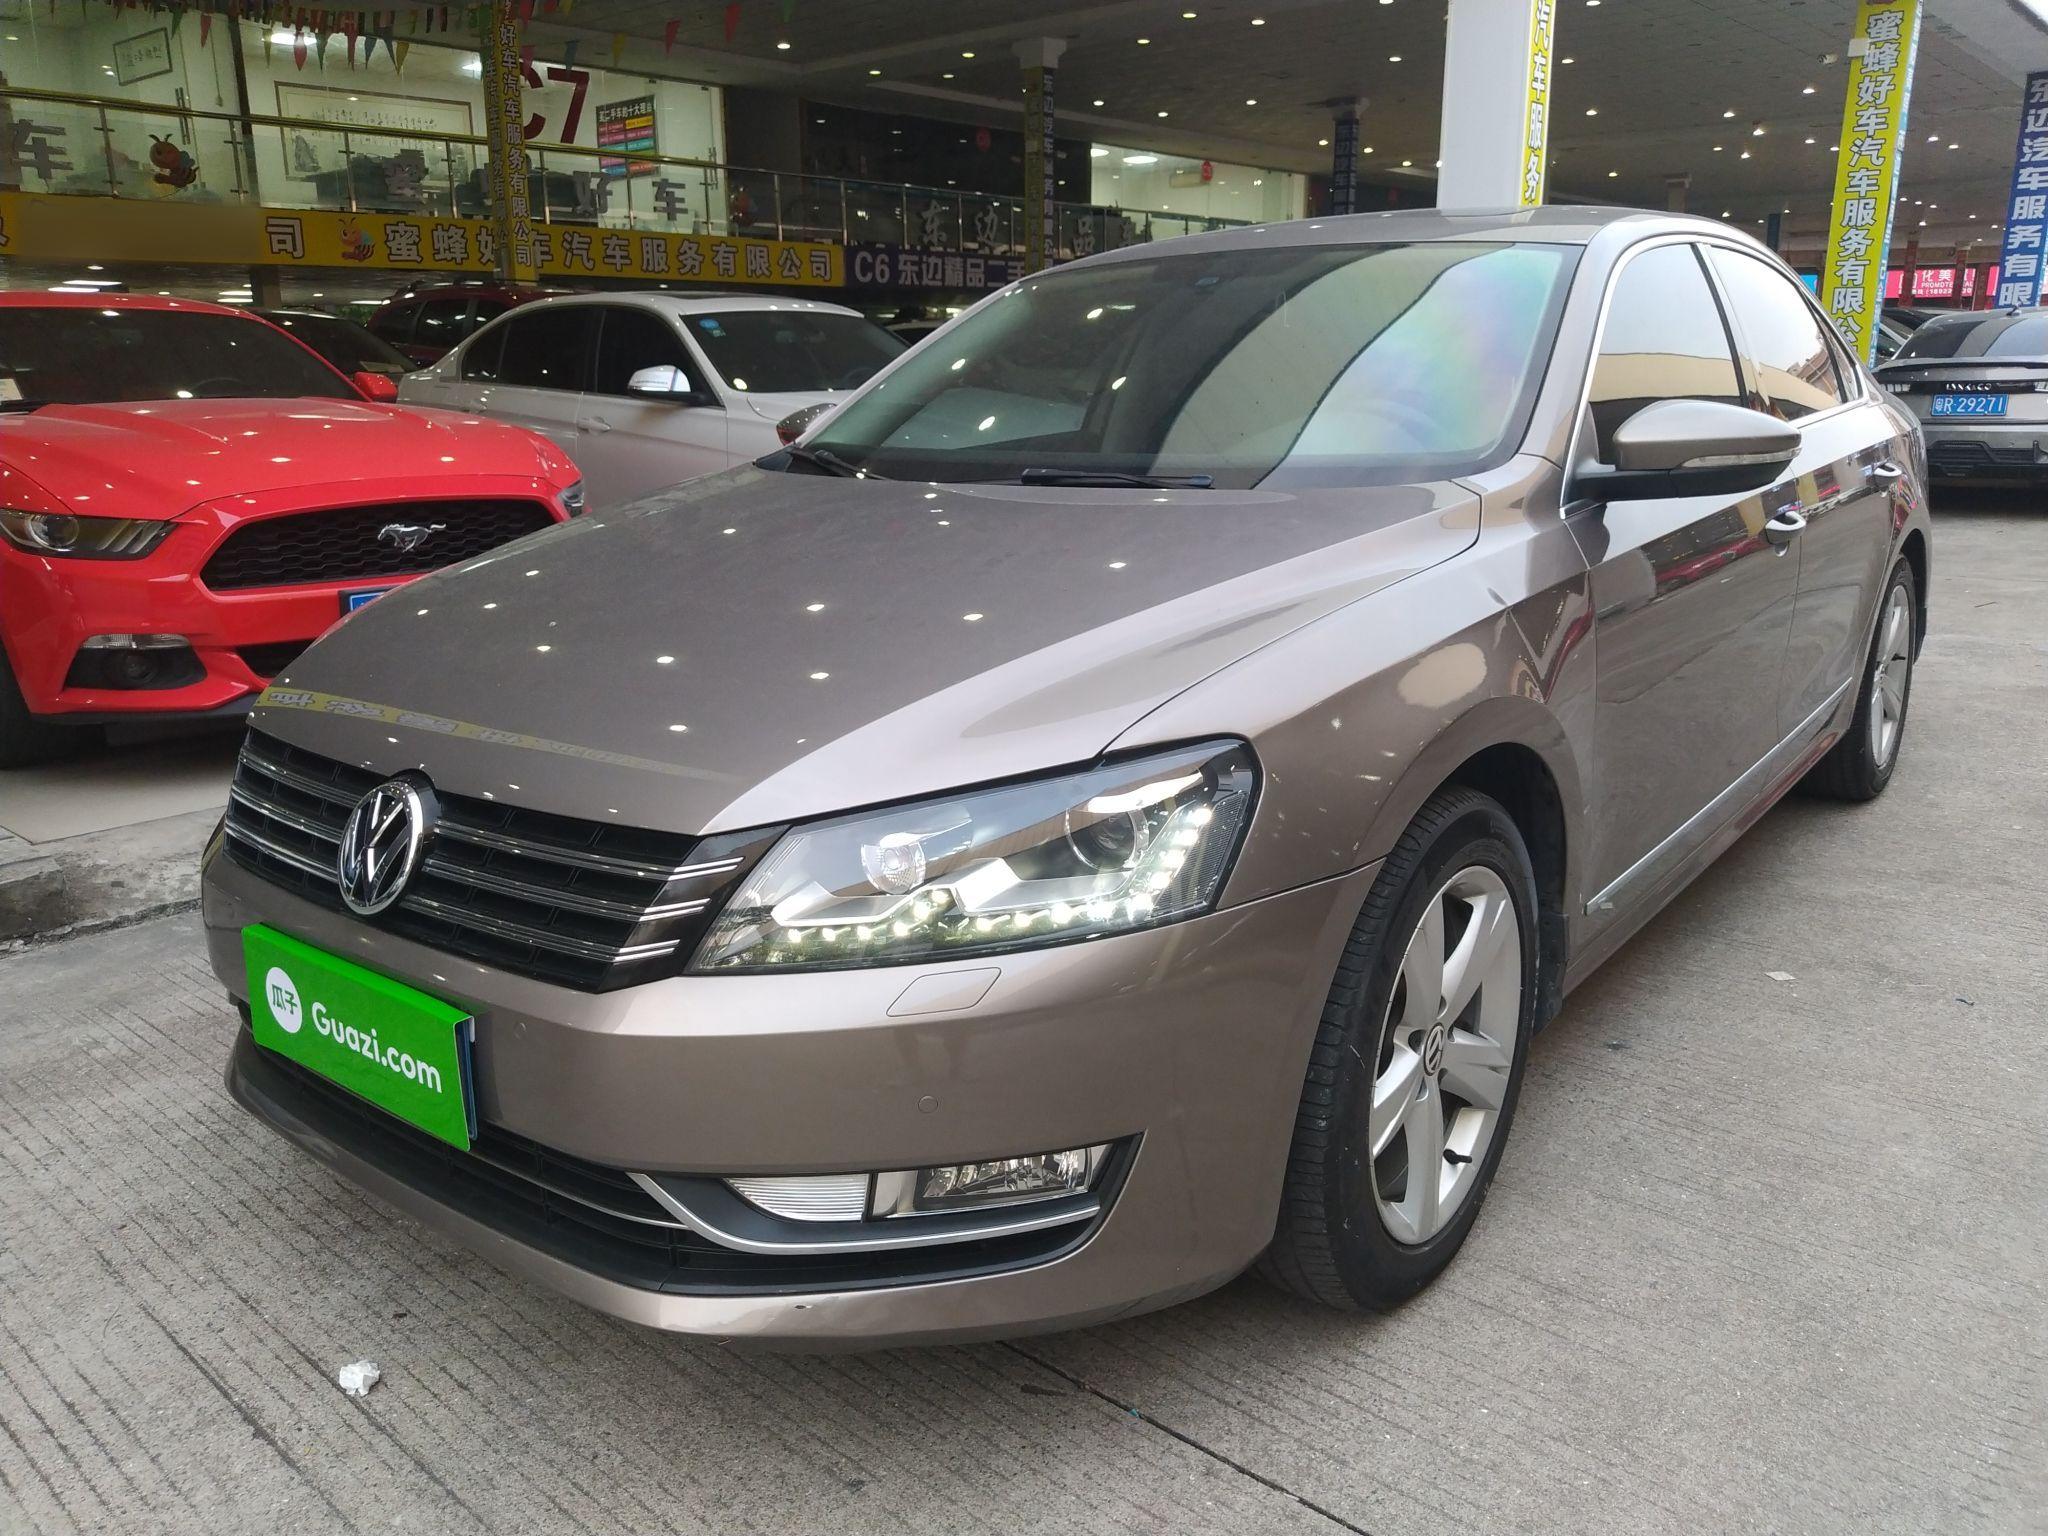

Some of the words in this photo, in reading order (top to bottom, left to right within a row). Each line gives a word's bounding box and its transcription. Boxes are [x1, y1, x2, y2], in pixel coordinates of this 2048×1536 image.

[1524, 0, 1551, 201] 汽车服务
[1831, 10, 1905, 352] 蜜蜂好车汽车服务有限公
[265, 216, 305, 259] 司
[854, 251, 890, 284] C6
[271, 983, 298, 1015] 瓜子
[312, 1001, 442, 1093] Guazi.com
